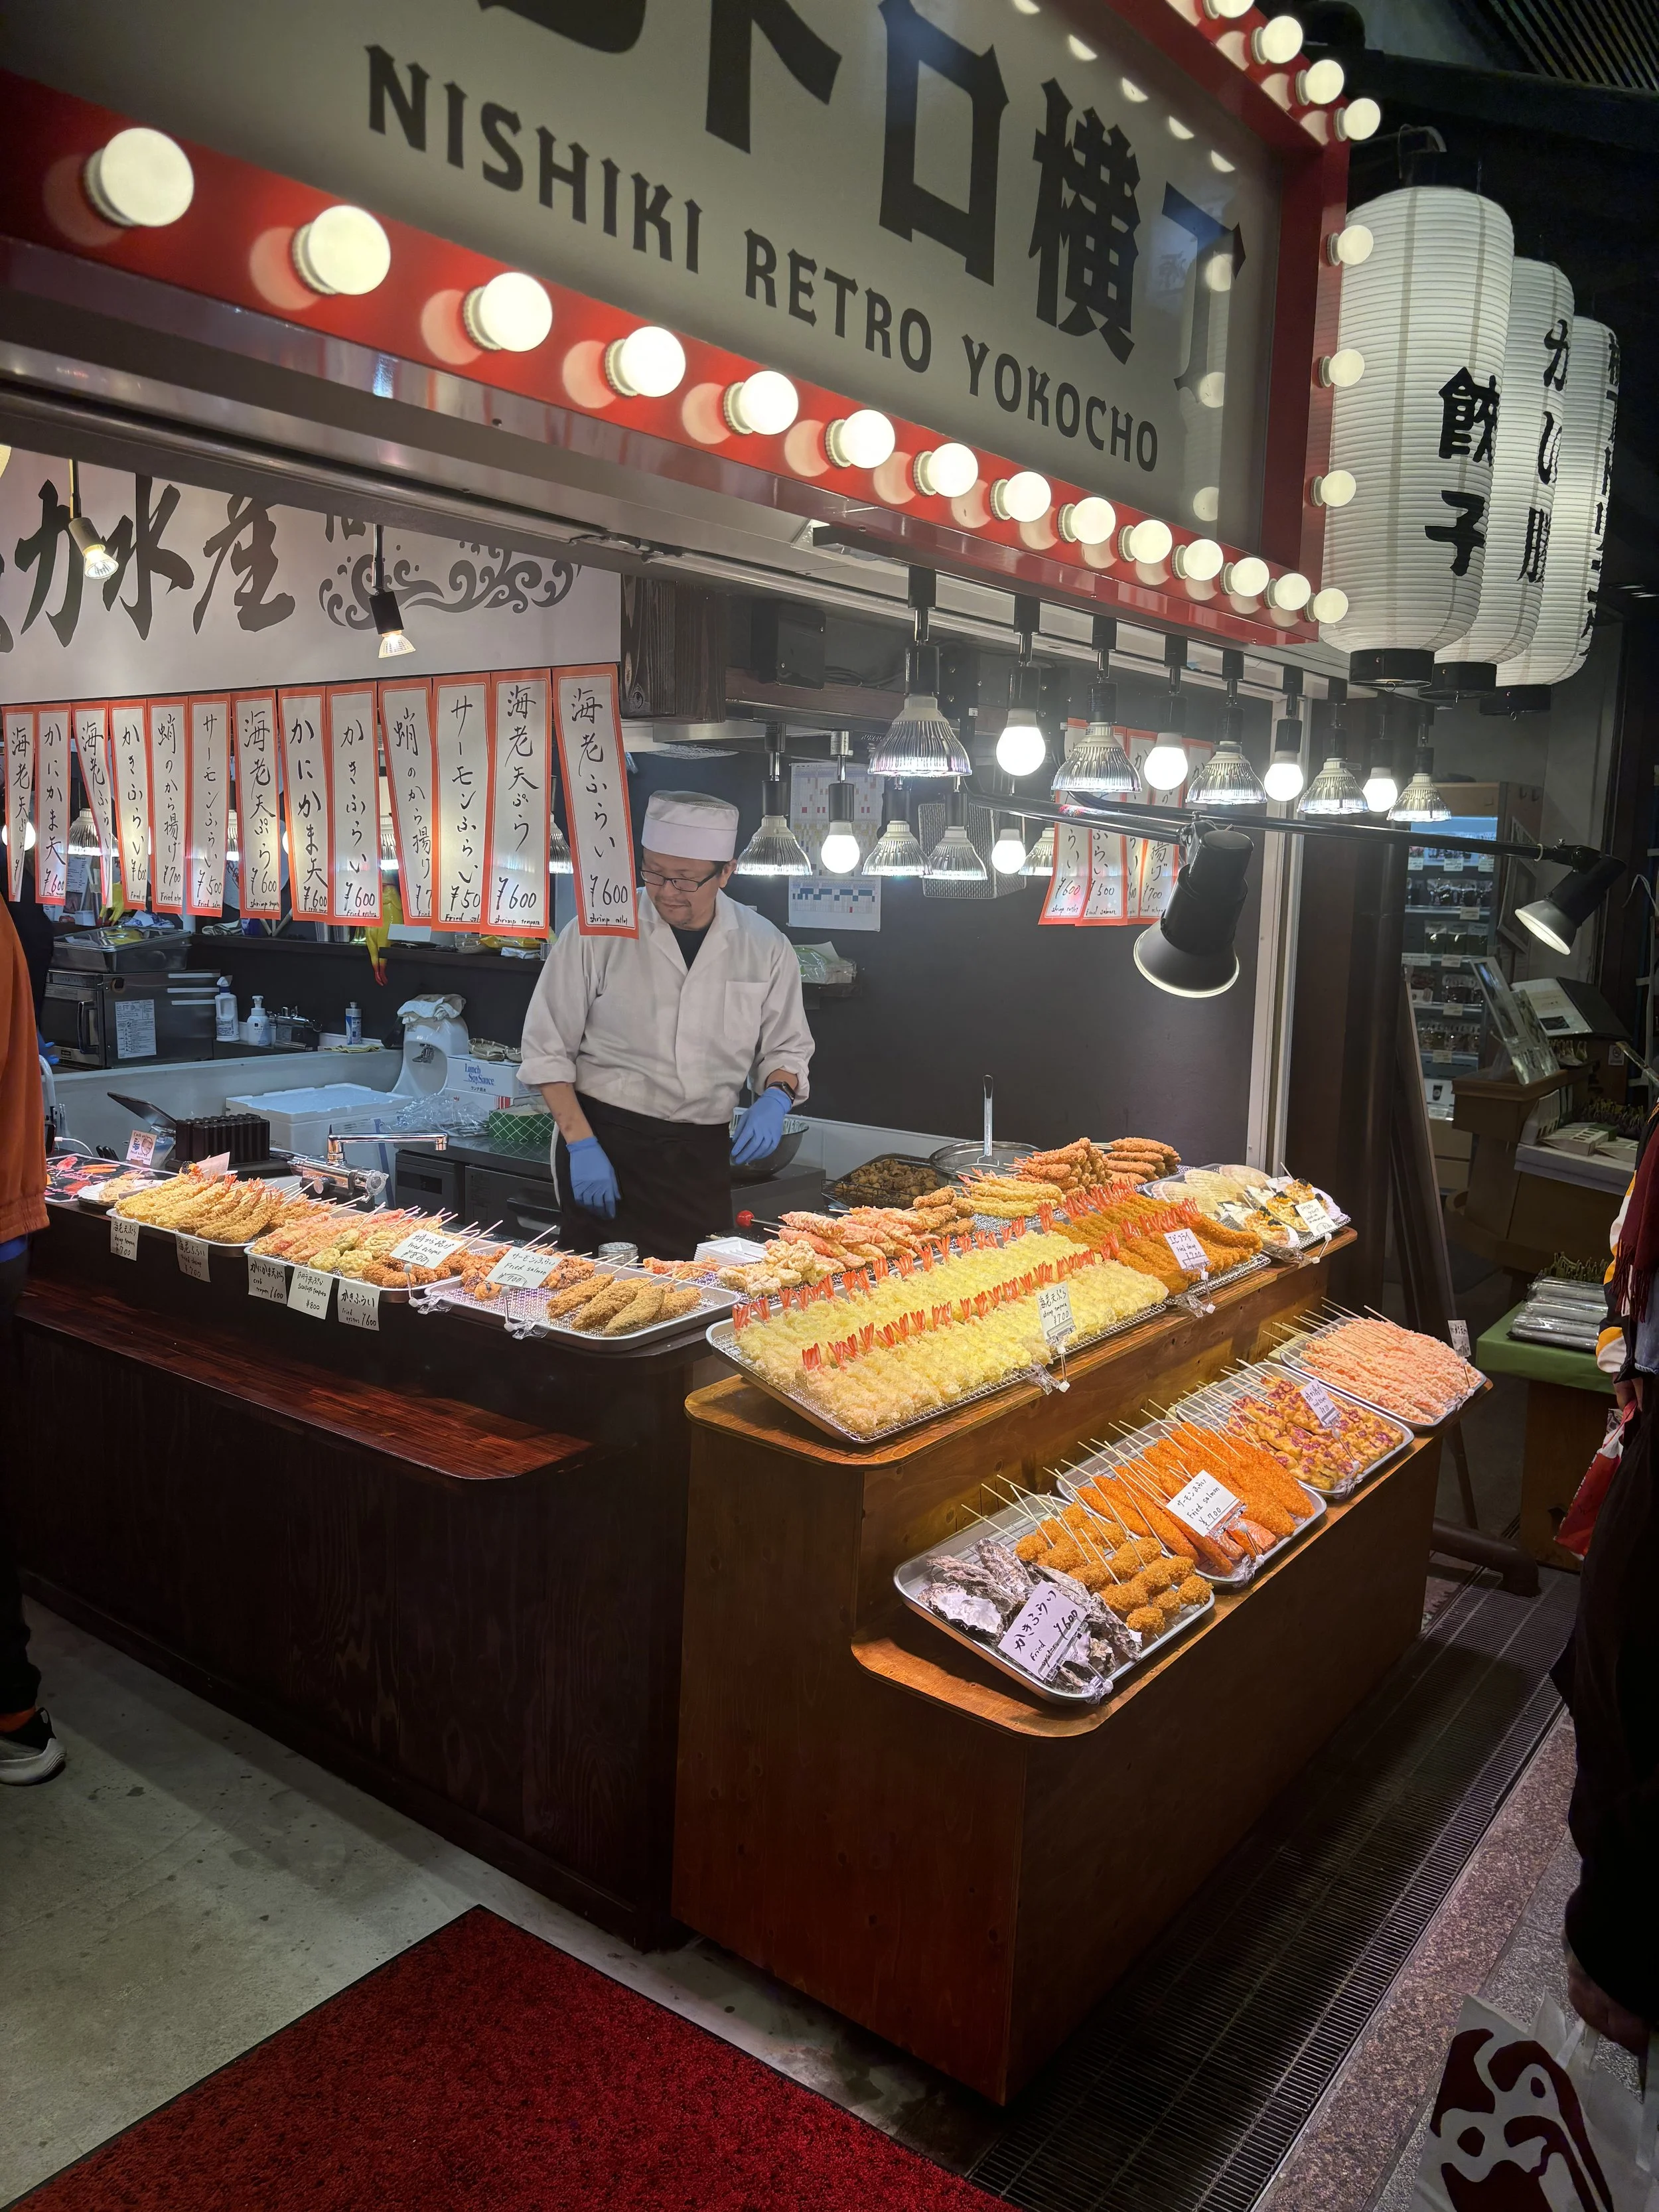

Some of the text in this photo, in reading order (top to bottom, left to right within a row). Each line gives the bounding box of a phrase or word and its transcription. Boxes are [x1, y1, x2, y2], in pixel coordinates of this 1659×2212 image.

[477, 0, 1246, 404] トロ横丁
[364, 44, 1158, 473] NISHIKI RETRO YOKOCHO
[1425, 366, 1501, 577] 餃子
[164, 865, 180, 886] ¥700
[197, 869, 222, 898] ¥500
[251, 867, 277, 895] ¥600
[303, 886, 326, 911] ¥600
[344, 882, 375, 911] ¥600
[496, 877, 536, 910] ¥600
[590, 874, 628, 907] ¥600
[465, 1063, 481, 1074] Lunch
[1187, 1487, 1220, 1519] Fried salmon
[1030, 1639, 1046, 1661] Fried
